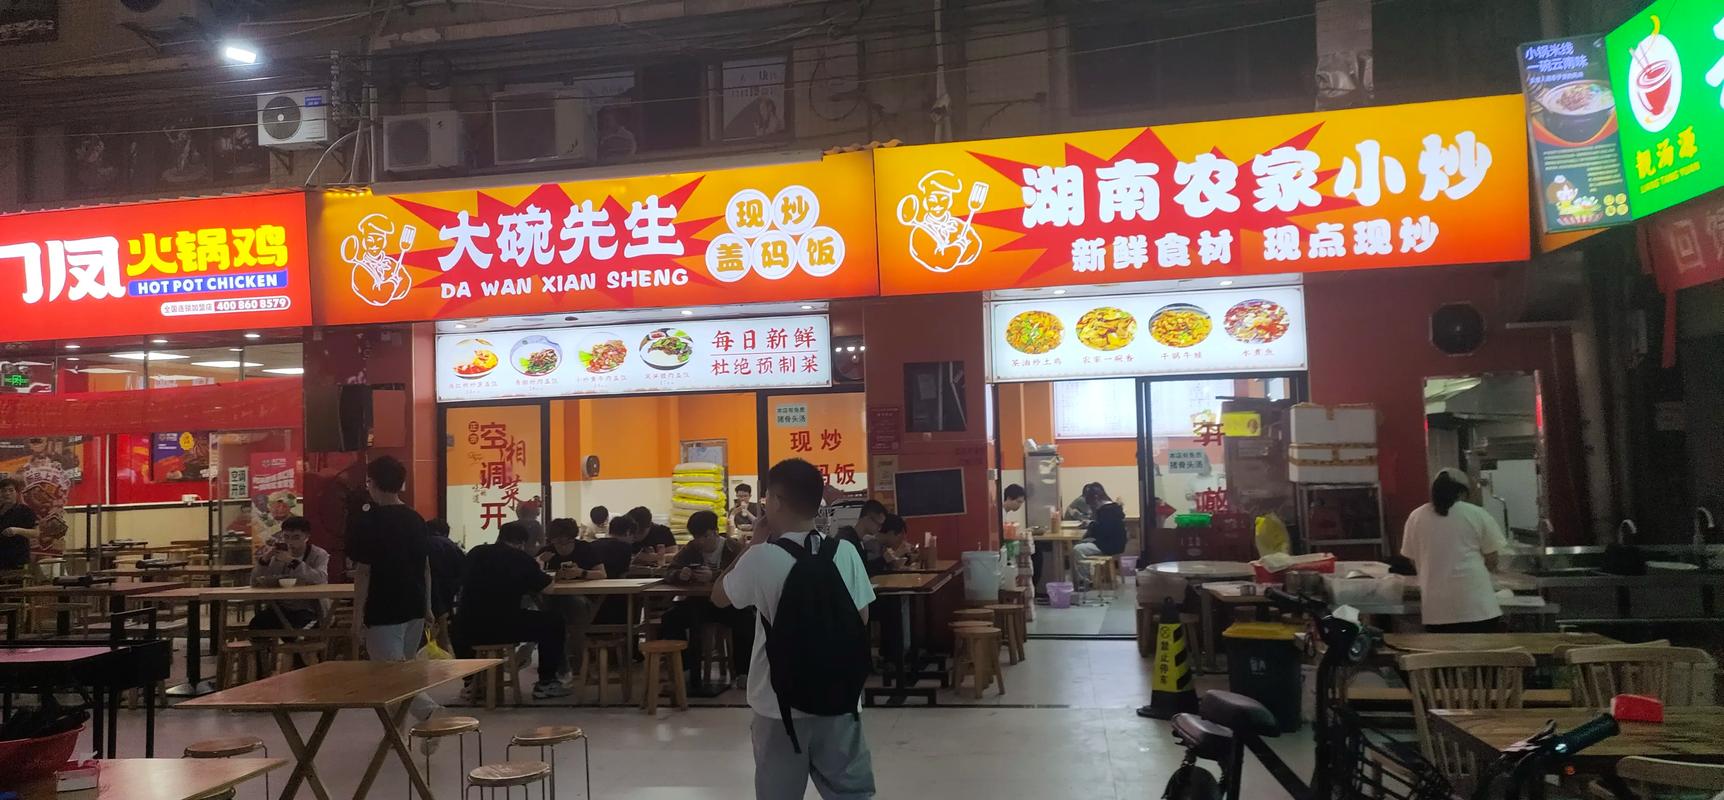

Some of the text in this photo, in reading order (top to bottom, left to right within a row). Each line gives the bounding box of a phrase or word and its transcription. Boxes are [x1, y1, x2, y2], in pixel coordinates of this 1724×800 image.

[1021, 130, 1493, 228] 湖南农家小炒
[736, 194, 810, 228] 现炒
[437, 194, 686, 273] 大碗先生
[1071, 215, 1440, 273] 新鲜食材 现点现炒
[126, 225, 288, 277] 火锅鸡
[715, 236, 836, 273] 盖码饭
[138, 273, 278, 295] HOT POT CHICKEN
[440, 268, 689, 299] DA WAN XIAN SHENG
[217, 297, 286, 312] 400 860 8579
[711, 325, 817, 352] 每日新鲜
[711, 355, 819, 376] 杜绝预制菜
[790, 428, 842, 453] 现炒
